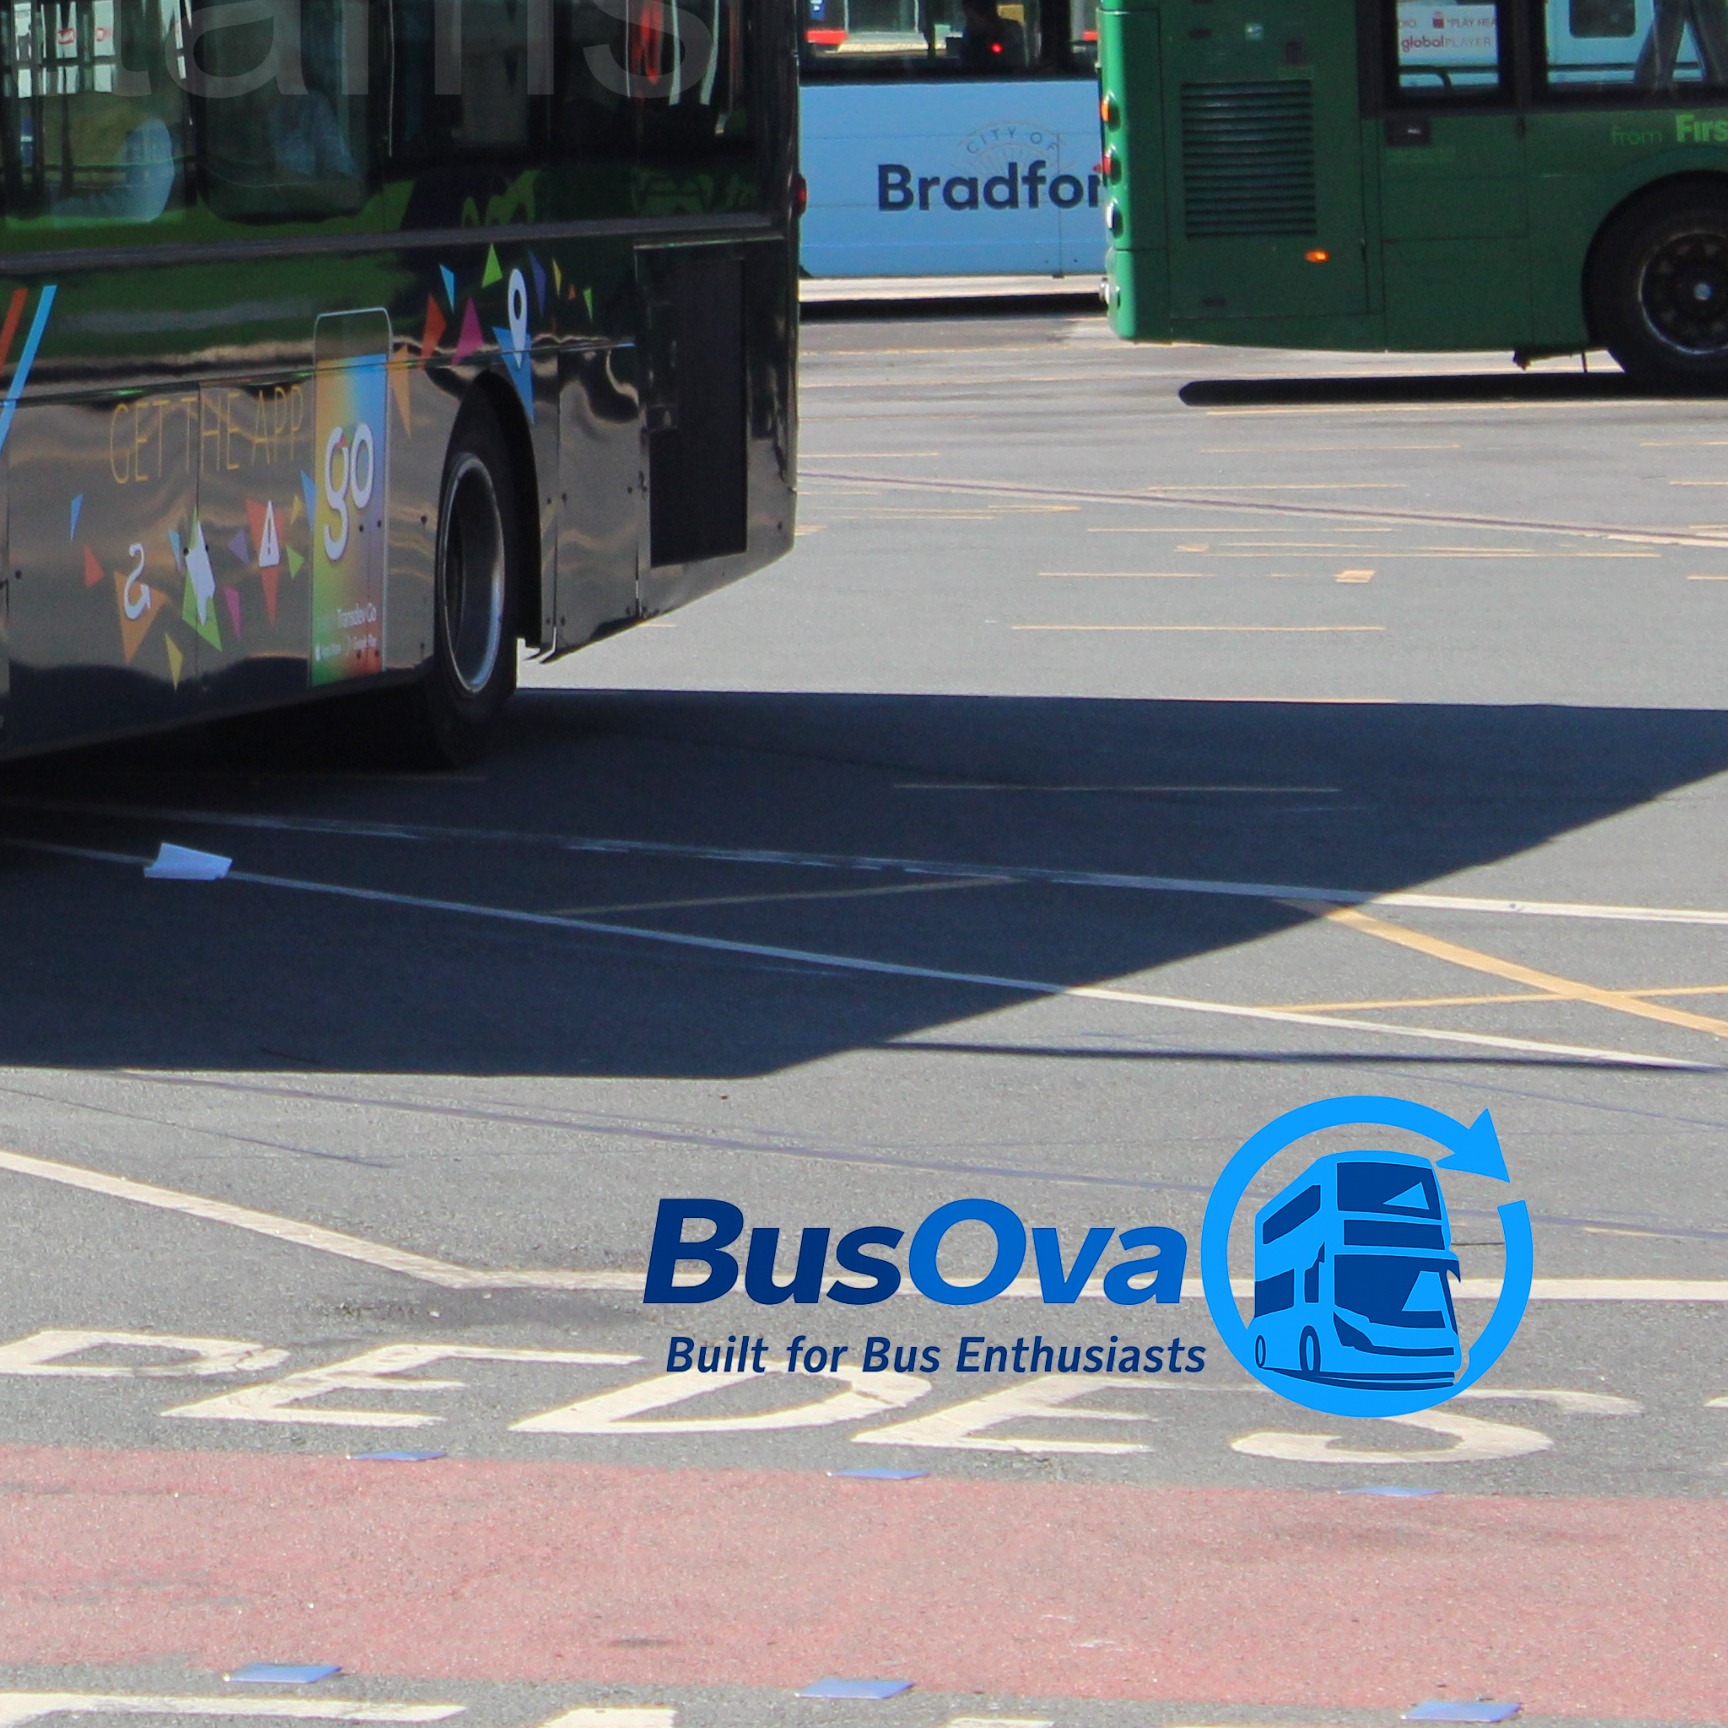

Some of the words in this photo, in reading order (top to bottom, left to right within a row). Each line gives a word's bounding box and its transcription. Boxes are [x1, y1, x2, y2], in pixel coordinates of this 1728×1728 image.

[966, 126, 1017, 155] CITY
[1029, 130, 1062, 152] OF
[109, 398, 171, 485] GET
[180, 391, 241, 473] THE
[250, 383, 304, 467] APP
[323, 422, 375, 561] go
